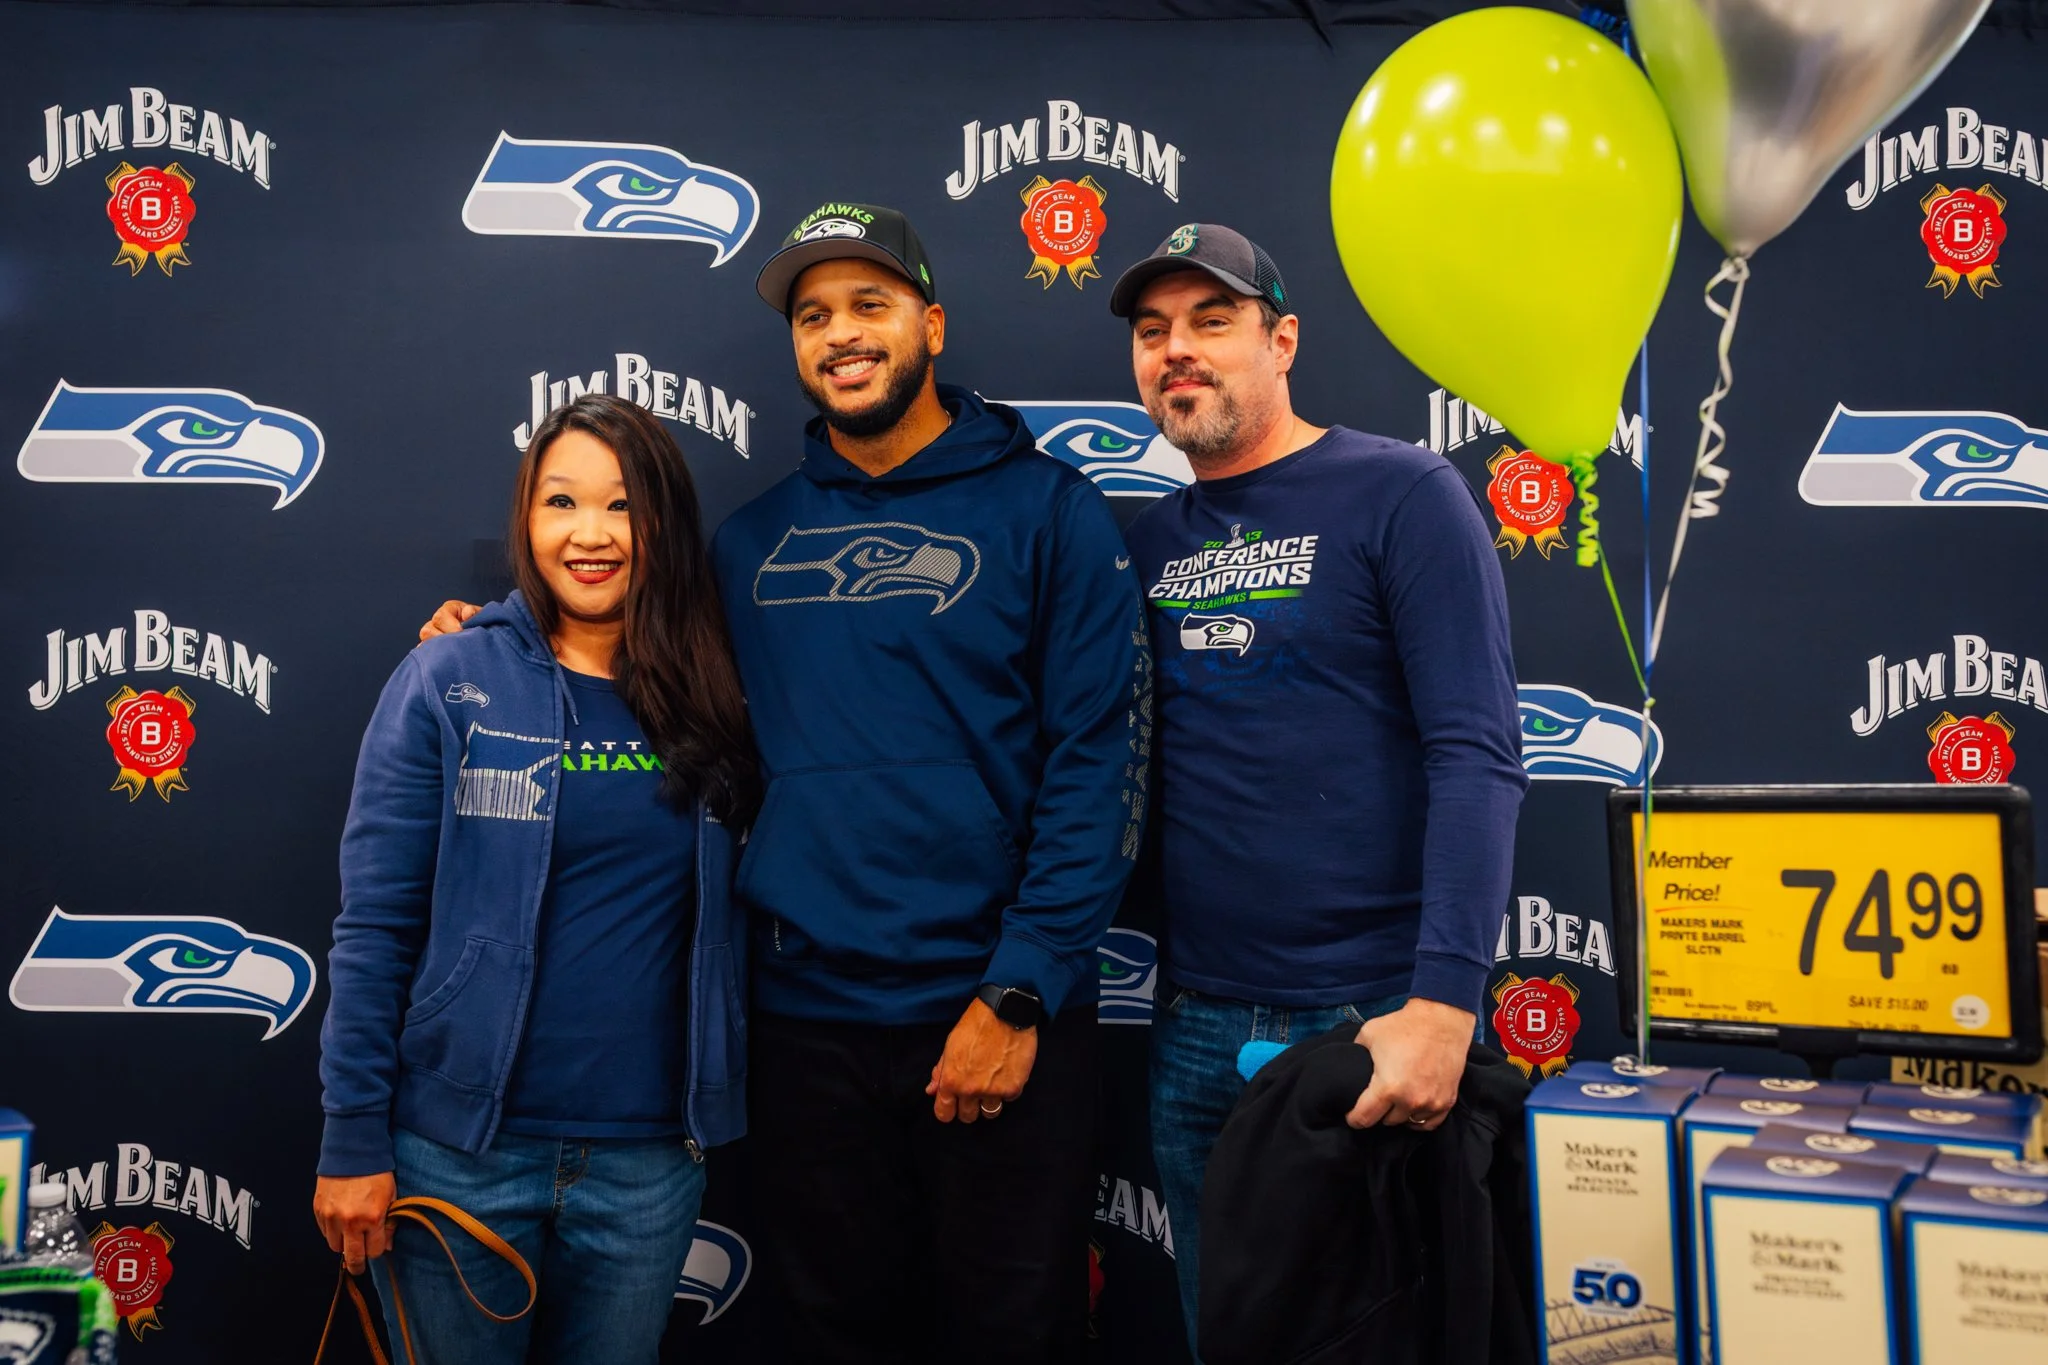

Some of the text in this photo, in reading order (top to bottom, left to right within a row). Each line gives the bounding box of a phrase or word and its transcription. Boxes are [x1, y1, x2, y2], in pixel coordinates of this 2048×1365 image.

[27, 86, 271, 190] JIM BEAM
[945, 100, 1180, 203] JIM BEAM
[1845, 107, 2048, 211] JIM BEA
[139, 180, 163, 188] BEAM
[121, 194, 130, 210] THE
[1052, 193, 1076, 201] BEAM
[1952, 202, 1975, 210] BEAM
[140, 197, 161, 220] B
[1035, 208, 1044, 223] THE
[122, 212, 158, 238] STANDARD
[160, 217, 180, 237] SINCE
[794, 203, 874, 241] SEAHAWKS
[1054, 210, 1073, 233] B
[1935, 216, 1944, 232] THE
[1953, 219, 1973, 242] B
[1036, 226, 1069, 251] STANDARD
[1072, 229, 1091, 248] SINCE
[1935, 234, 1969, 260] STANDARD
[1971, 238, 1991, 258] SINCE
[615, 352, 751, 460] BEAM
[1519, 464, 1542, 472] BEAM
[1501, 478, 1510, 493] THE
[1520, 480, 1540, 504] B
[1502, 495, 1536, 522] STANDARD
[1538, 500, 1558, 519] SINCE
[1203, 530, 1263, 549] 20 13
[1162, 534, 1320, 579] CONFERENCE
[1148, 562, 1313, 600] CHAMPIONS
[1192, 592, 1247, 610] SEAHAWKS
[28, 609, 272, 715] JIM BEAM
[1850, 652, 1947, 737] JIM
[140, 704, 163, 712] BEAM
[121, 719, 130, 734] THE
[141, 721, 161, 745] B
[1960, 730, 1984, 738] BEAM
[122, 736, 157, 763] STANDARD
[159, 741, 179, 761] SINCE
[1942, 745, 1951, 760] THE
[1961, 747, 1982, 770] B
[1942, 762, 1966, 784] STAND
[1648, 851, 1733, 869] Member
[1664, 883, 1720, 901] Price!
[1660, 917, 1744, 930] MAKERS MARK
[1517, 896, 1617, 976] BEA
[1702, 932, 1746, 944] BARREL
[1685, 944, 1722, 955] SLCTN
[1848, 995, 1882, 1008] SAVE
[1507, 1006, 1516, 1021] THE
[1526, 1009, 1546, 1032] B
[1508, 1024, 1542, 1050] STANDARD
[1545, 1028, 1565, 1048] SINCE
[114, 1142, 254, 1250] BEAM
[118, 1240, 142, 1249] BEAM
[98, 1256, 107, 1271] THE
[117, 1258, 138, 1282] B
[97, 1274, 132, 1301] SDARD
[134, 1279, 155, 1299] SINCE
[1573, 1270, 1642, 1310] 50
